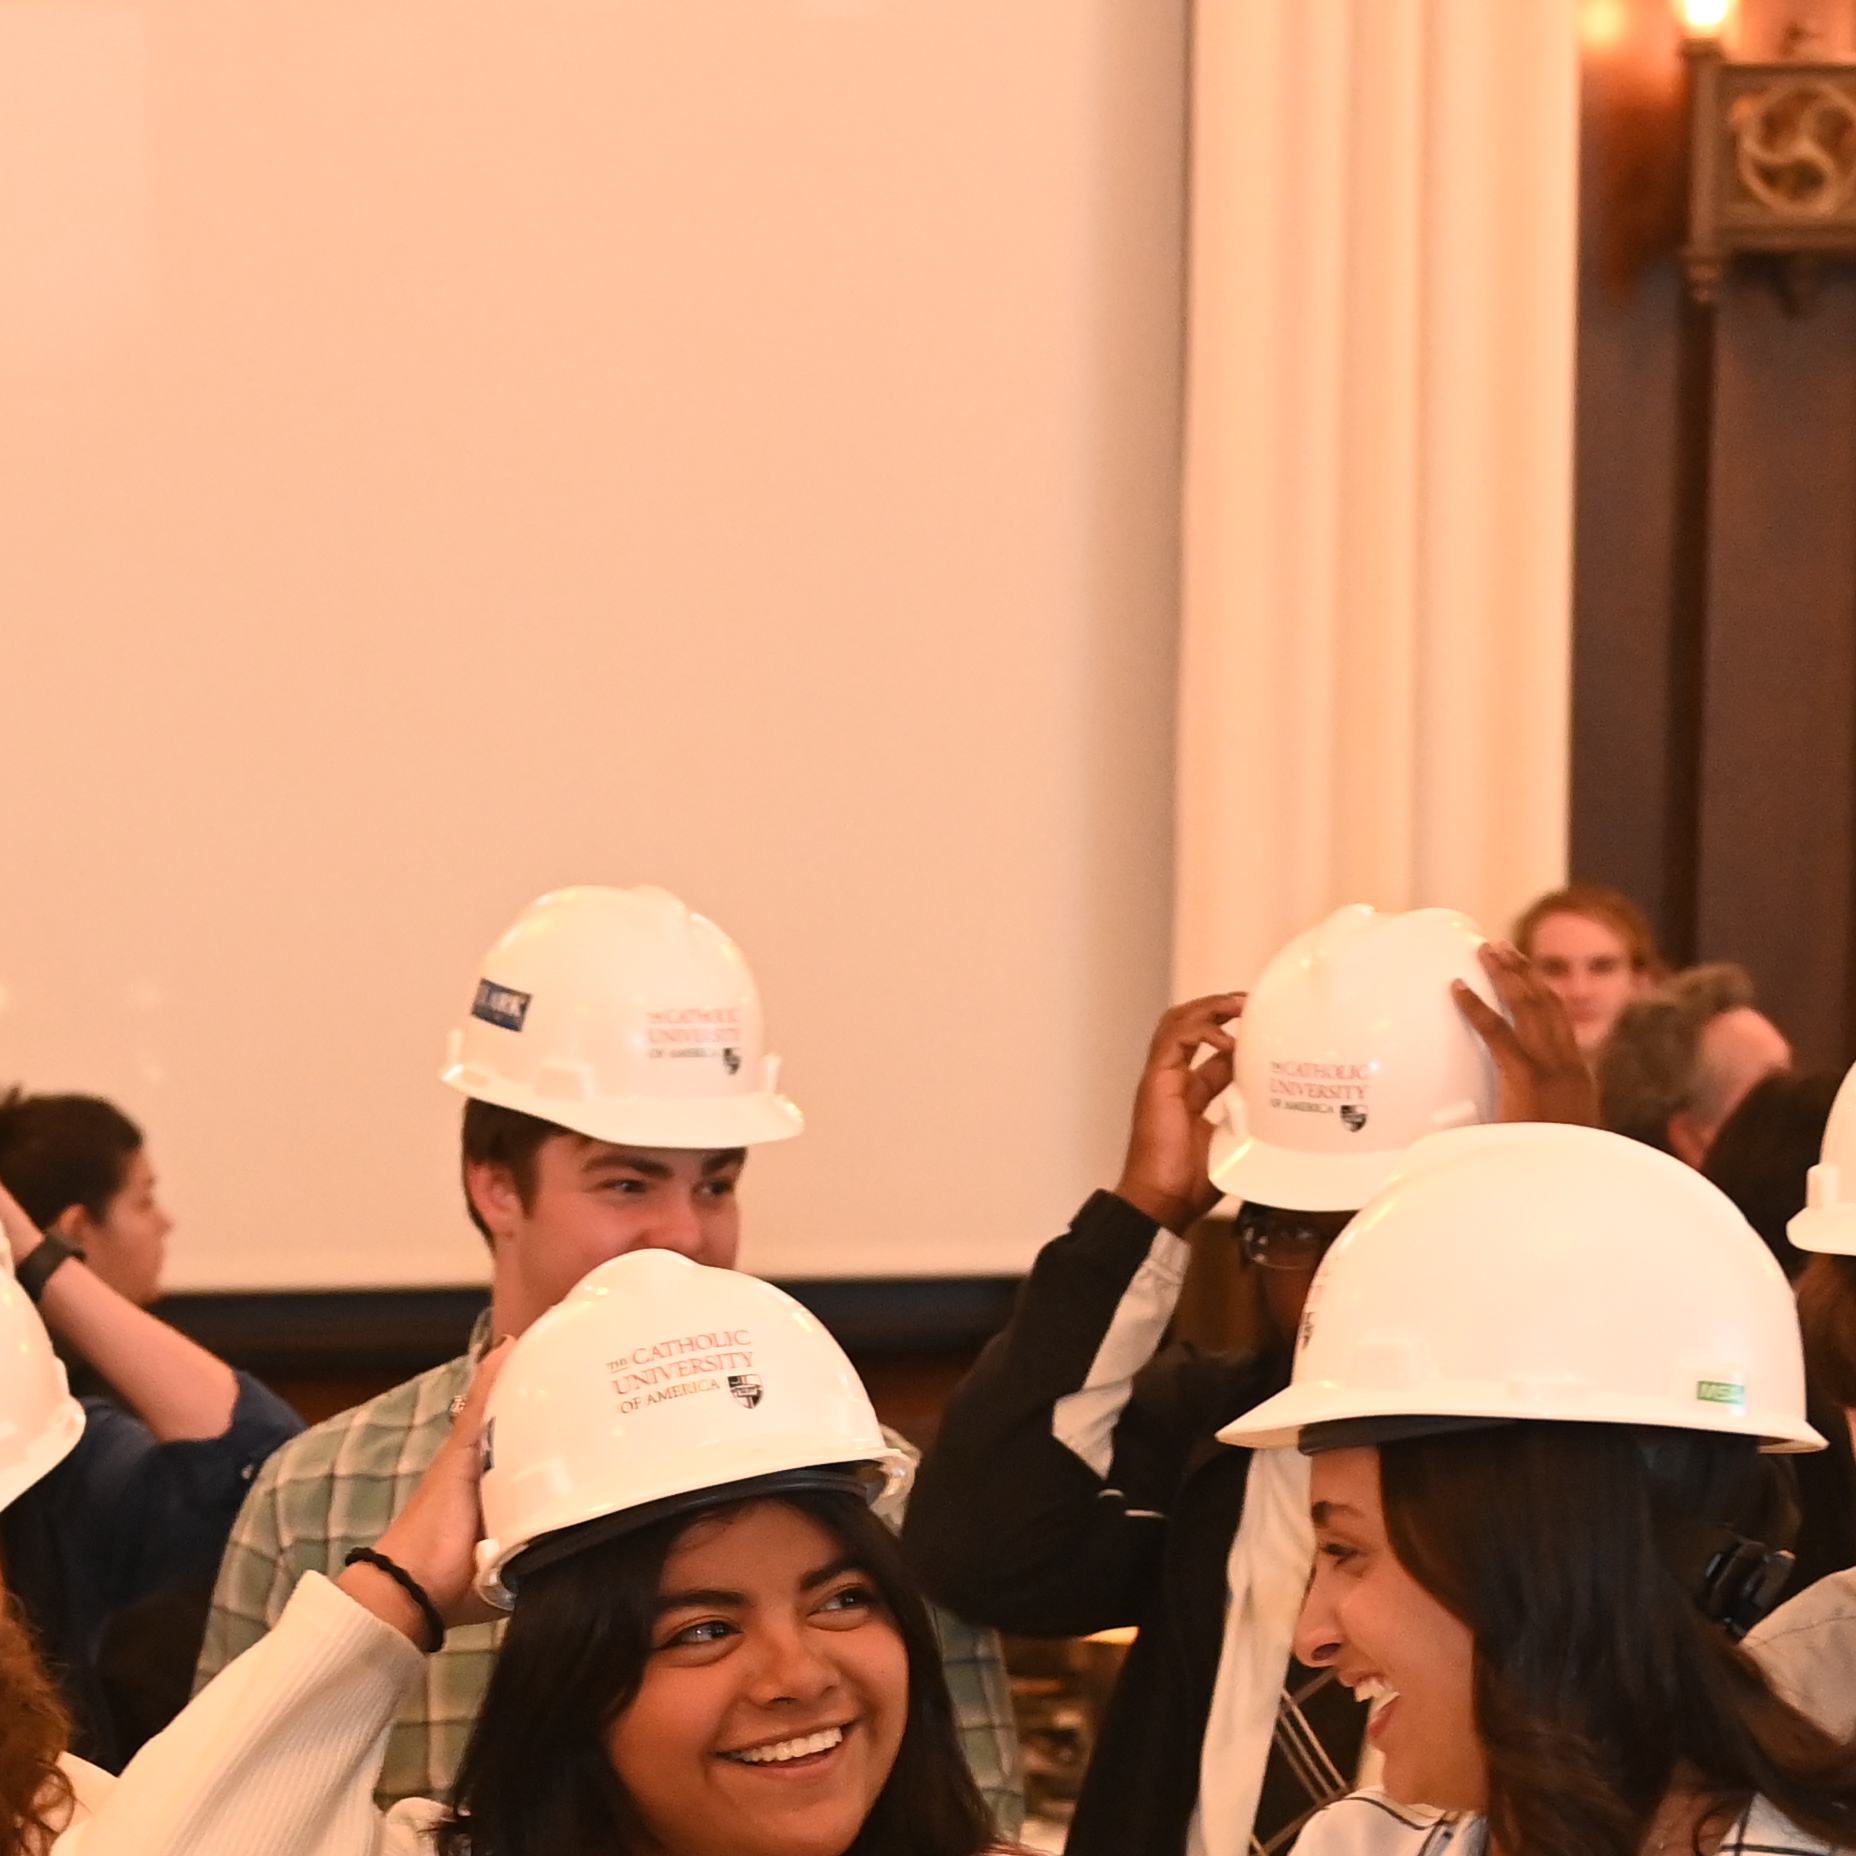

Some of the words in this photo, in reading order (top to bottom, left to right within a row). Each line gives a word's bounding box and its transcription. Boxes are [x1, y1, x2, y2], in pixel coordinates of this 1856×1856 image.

[1284, 1060, 1369, 1080] CATHOLIC
[1270, 1079, 1369, 1100] UNIVERSITY
[632, 1329, 752, 1365] CATHOLIC
[612, 1351, 754, 1396] UNIVERSITY
[620, 1397, 643, 1414] OF
[646, 1378, 721, 1406] AMERICA
